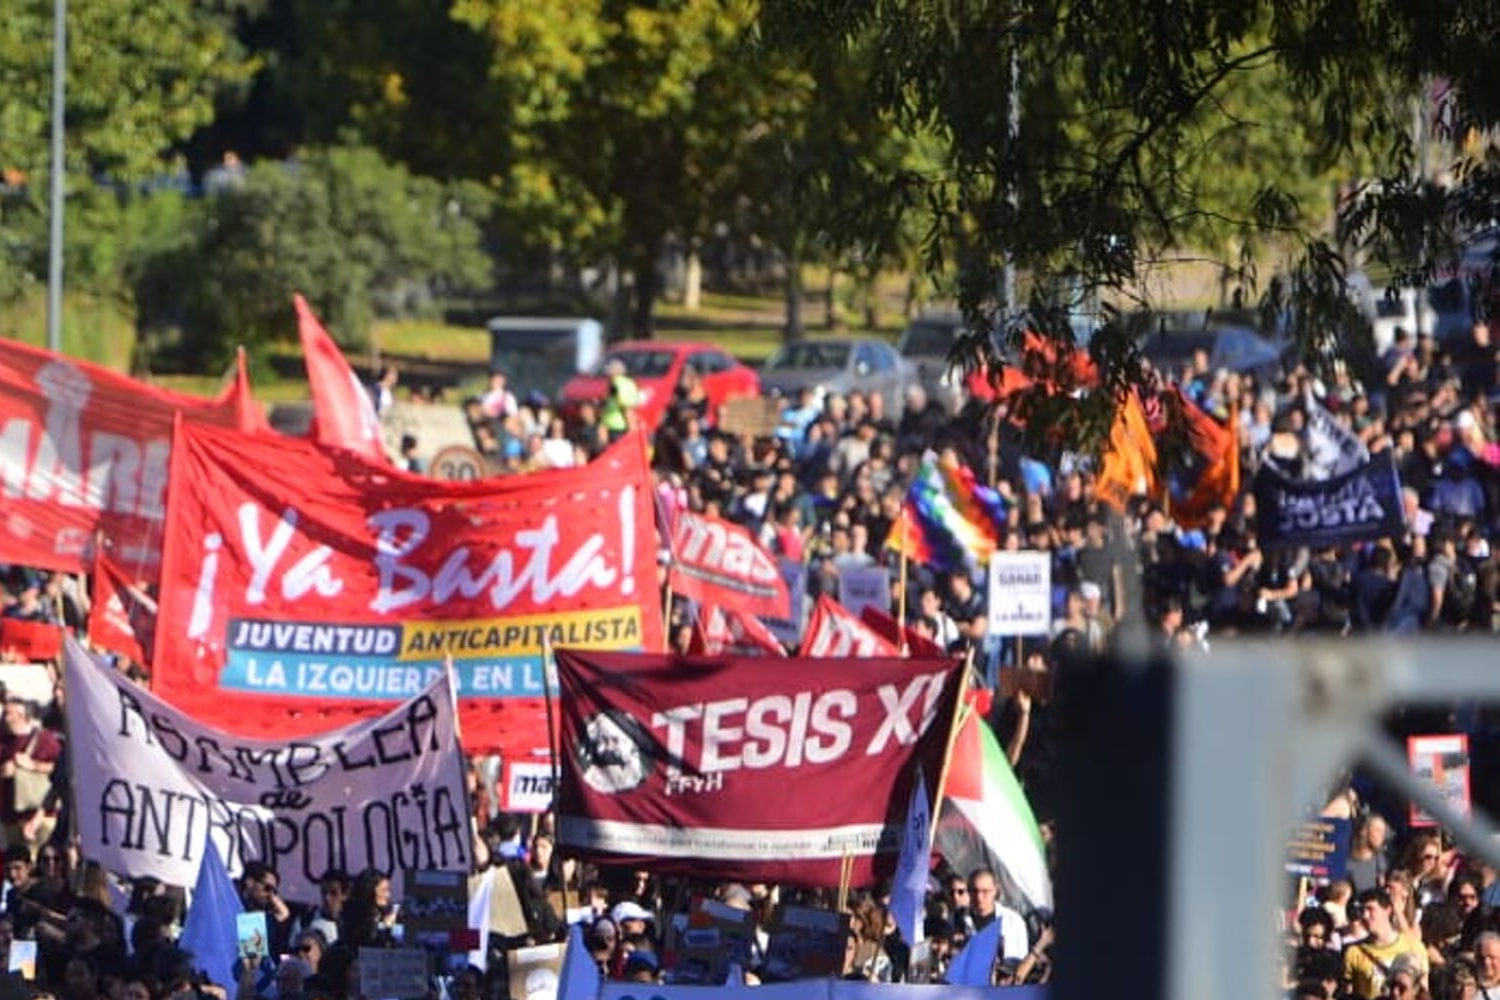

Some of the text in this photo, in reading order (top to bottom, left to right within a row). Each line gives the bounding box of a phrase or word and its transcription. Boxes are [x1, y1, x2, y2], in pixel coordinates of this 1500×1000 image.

[440, 459, 477, 481] 30
[367, 484, 637, 614] Basta!
[678, 512, 779, 582] mas
[234, 613, 639, 654] JUVENTUD ANTICAPITALISTA
[246, 658, 287, 689] LA
[473, 664, 514, 692] EN
[116, 688, 441, 788] ASAMBLEA
[651, 688, 857, 774] TESIS
[260, 787, 313, 811] de
[513, 775, 554, 795] ma
